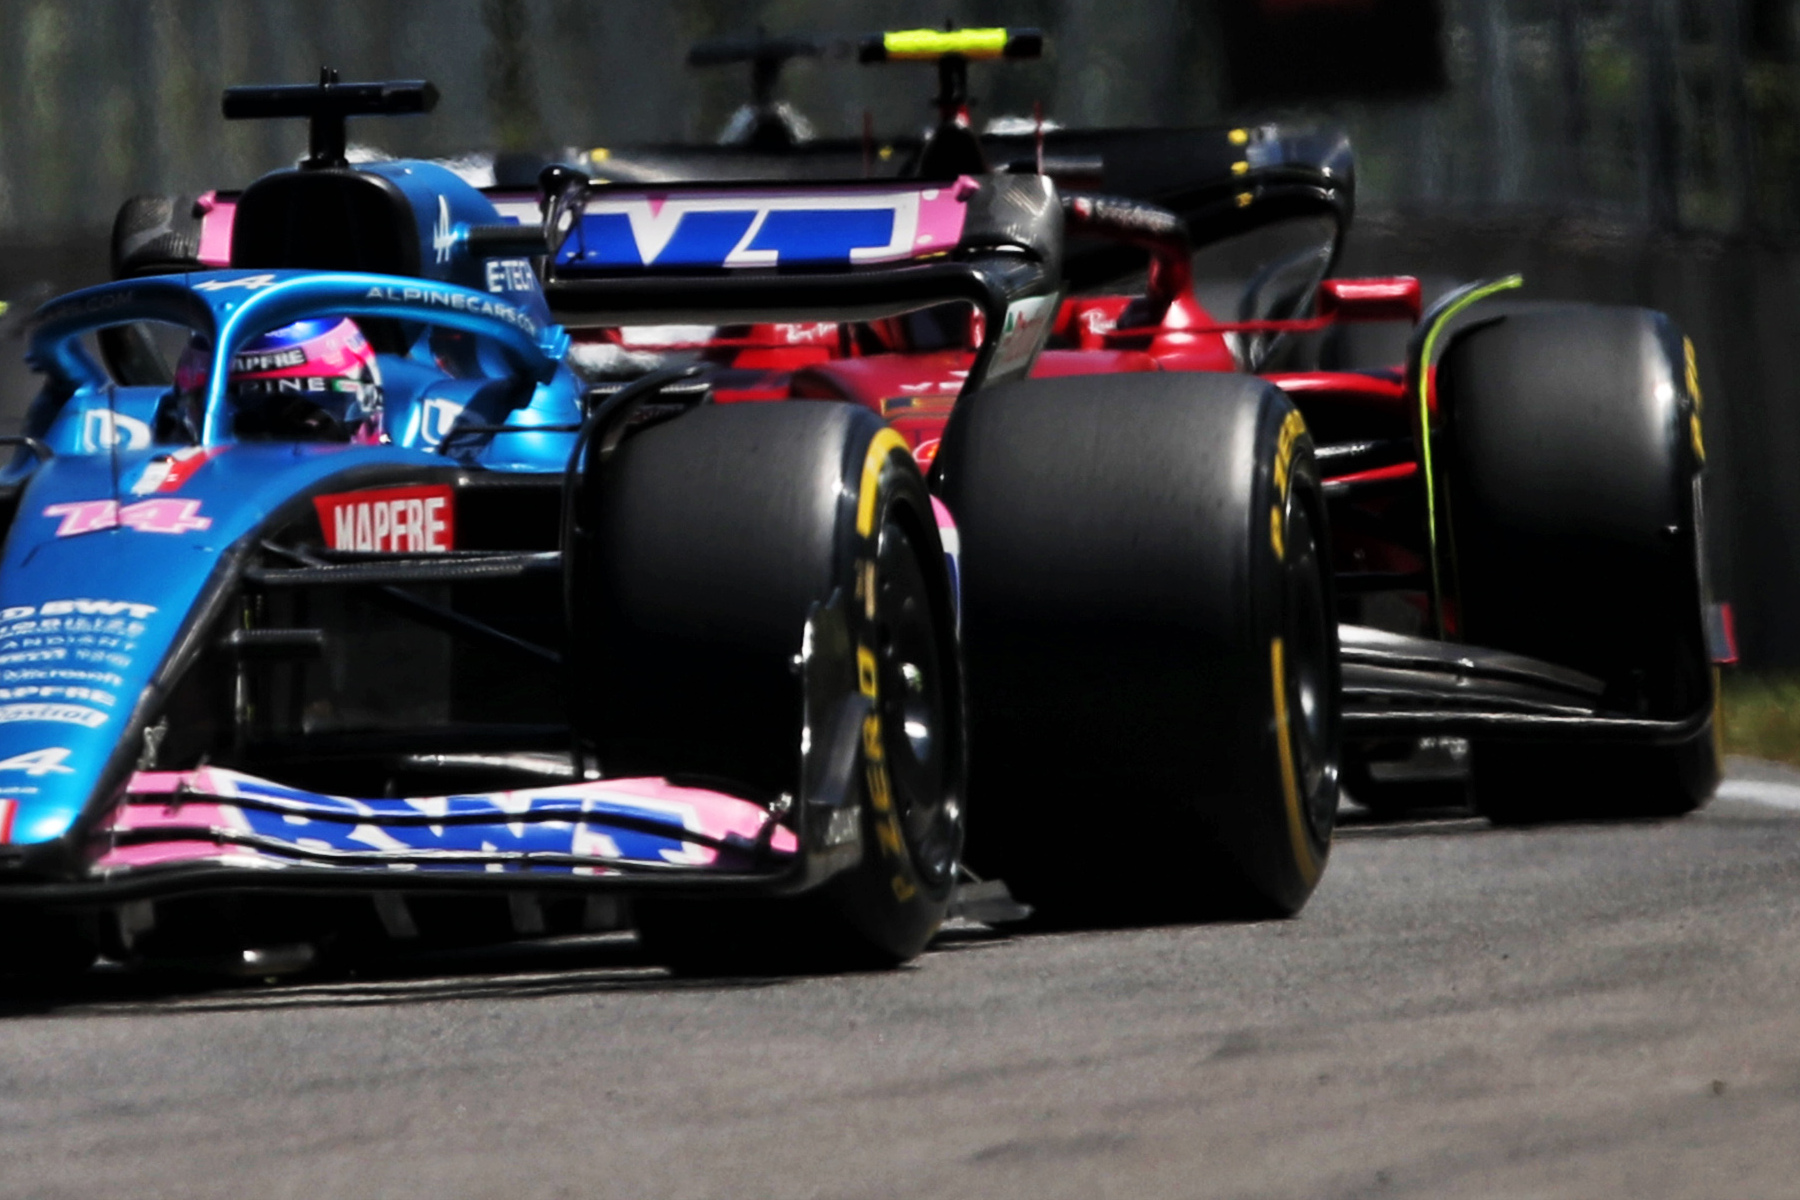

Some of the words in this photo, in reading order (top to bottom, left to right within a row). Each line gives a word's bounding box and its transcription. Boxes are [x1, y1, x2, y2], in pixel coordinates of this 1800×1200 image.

[231, 349, 305, 373] APFRE
[334, 497, 447, 553] MAPFRE
[39, 598, 159, 619] BWT
